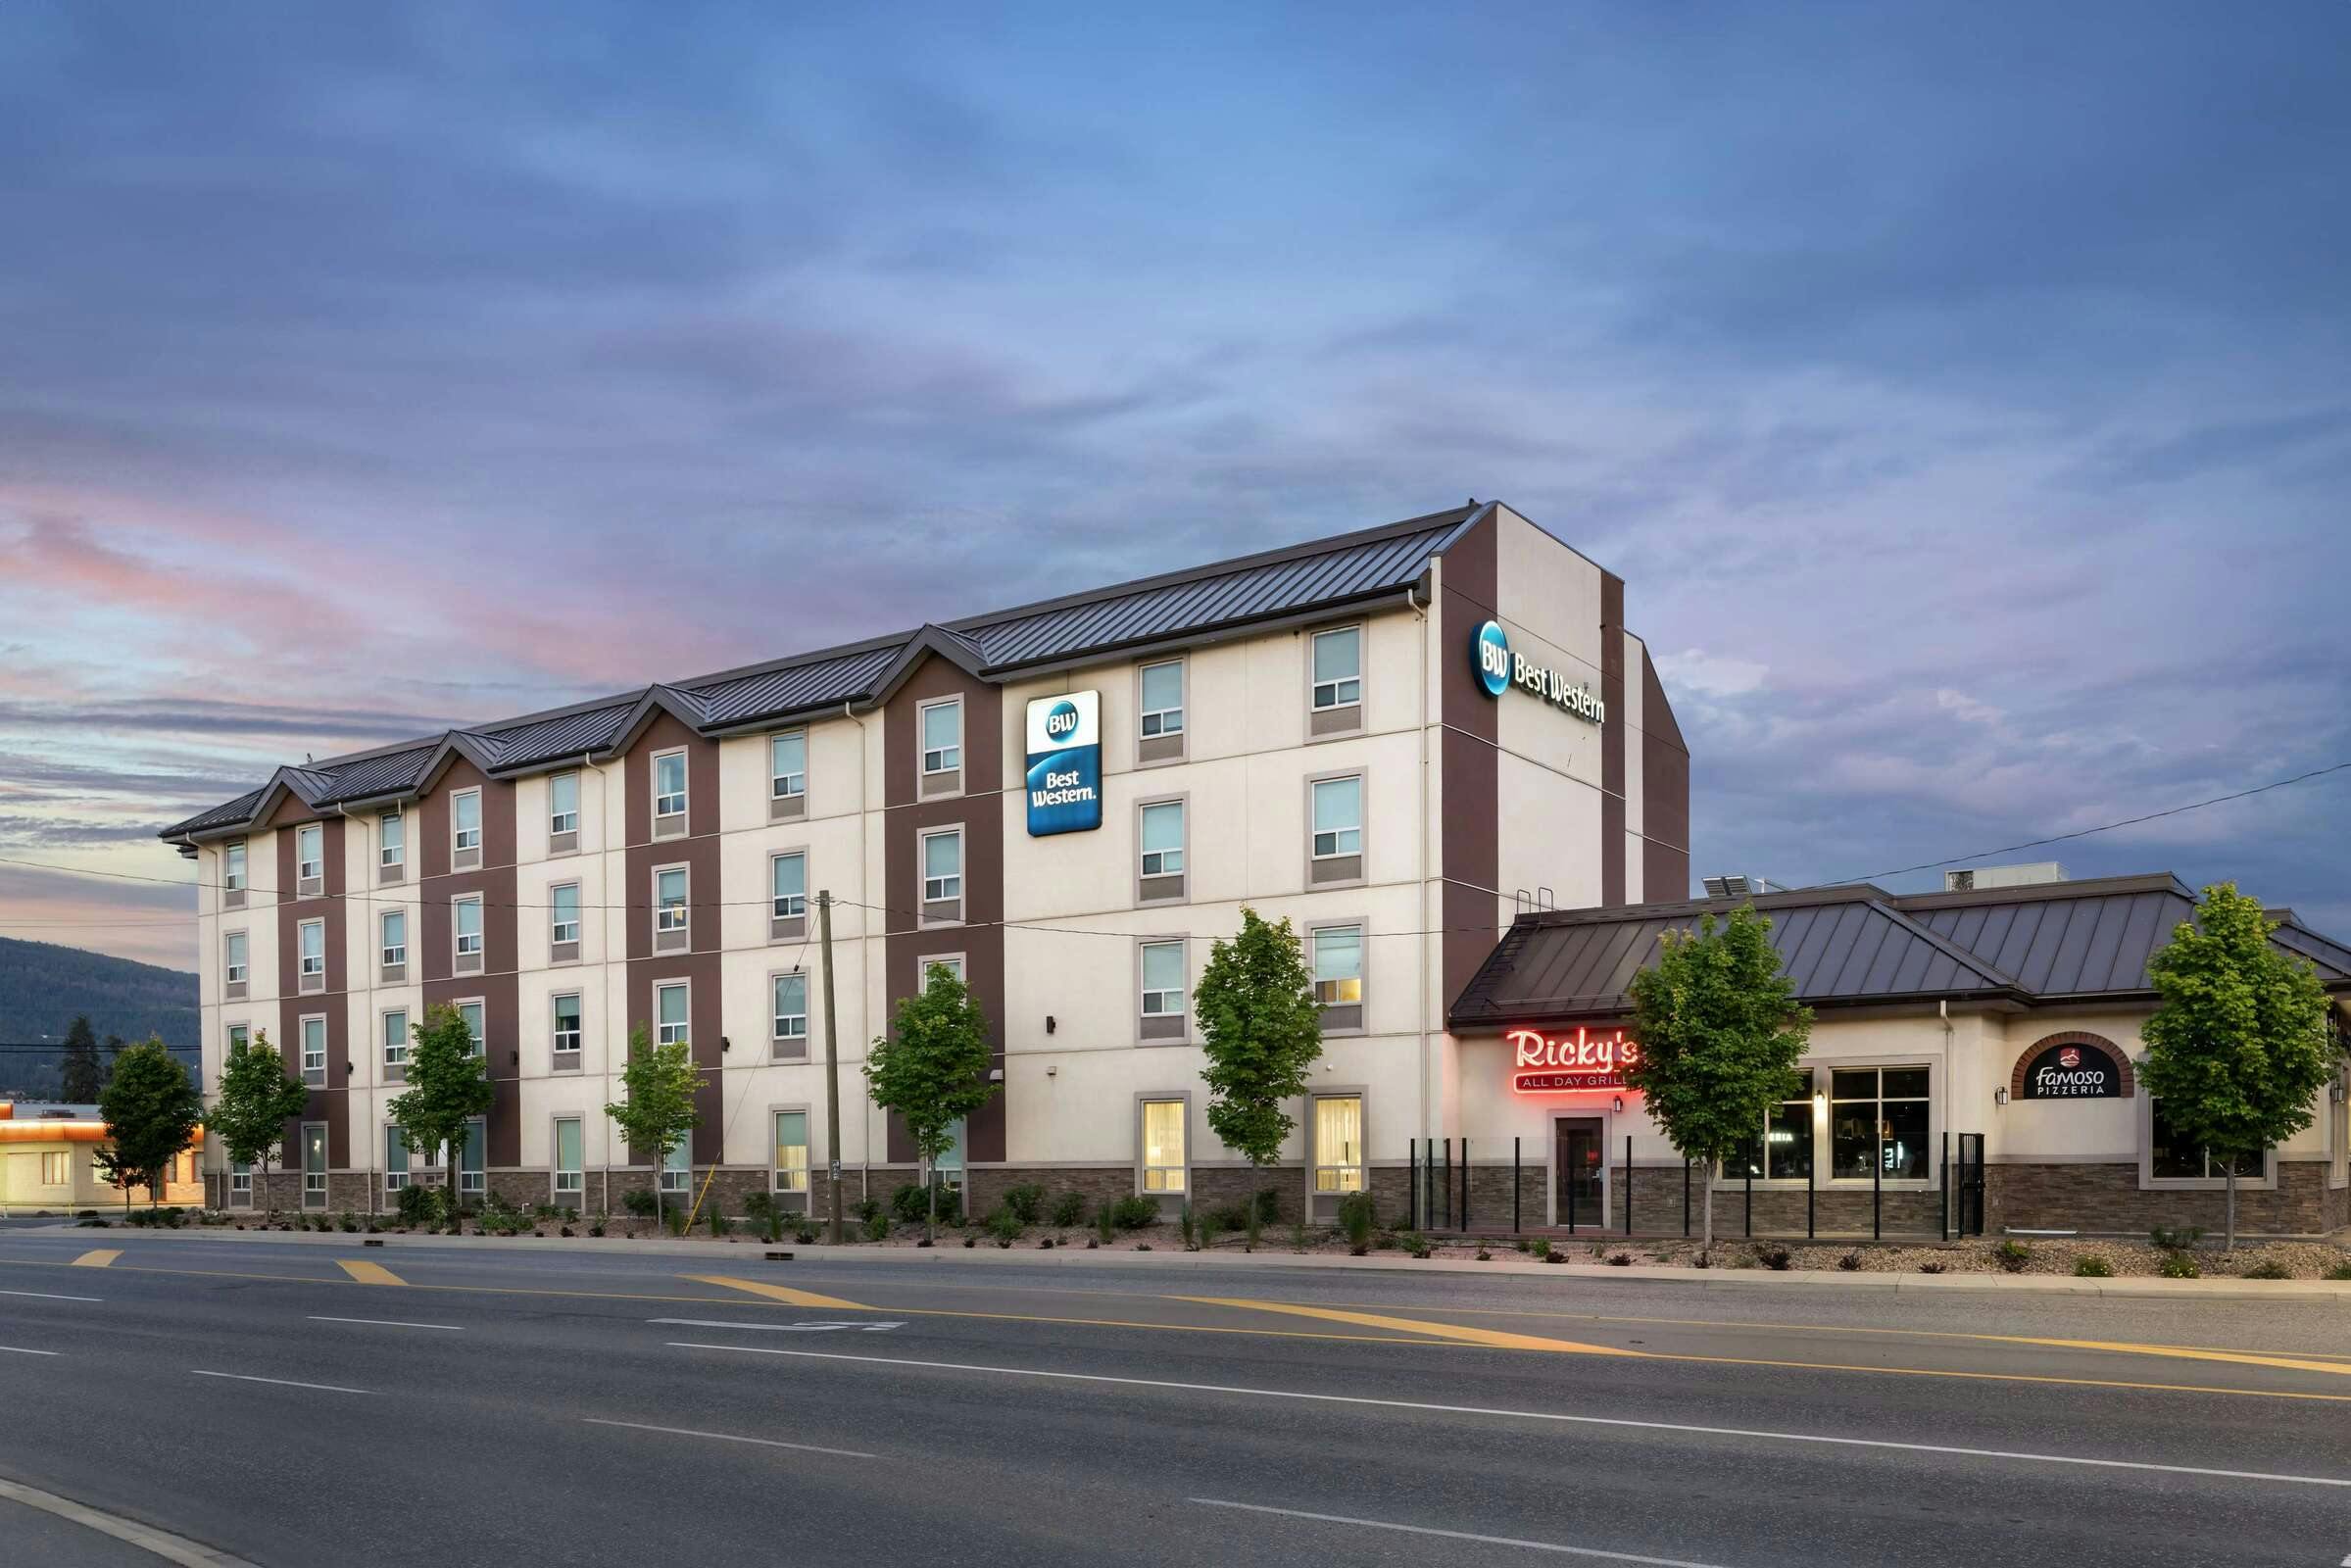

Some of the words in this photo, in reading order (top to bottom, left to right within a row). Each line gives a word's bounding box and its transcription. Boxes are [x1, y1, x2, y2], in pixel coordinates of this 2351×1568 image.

[1482, 640, 1508, 678] BW
[1514, 652, 1547, 695] Best
[1549, 669, 1605, 723] Western
[1049, 711, 1077, 734] BW
[1047, 770, 1080, 789] Best
[1506, 1027, 1639, 1074] Ricky's
[1522, 1077, 1549, 1088] ALL
[1554, 1077, 1582, 1087] DAY
[2035, 1066, 2105, 1086] Famoso
[2037, 1085, 2105, 1096] PIZZERIA
